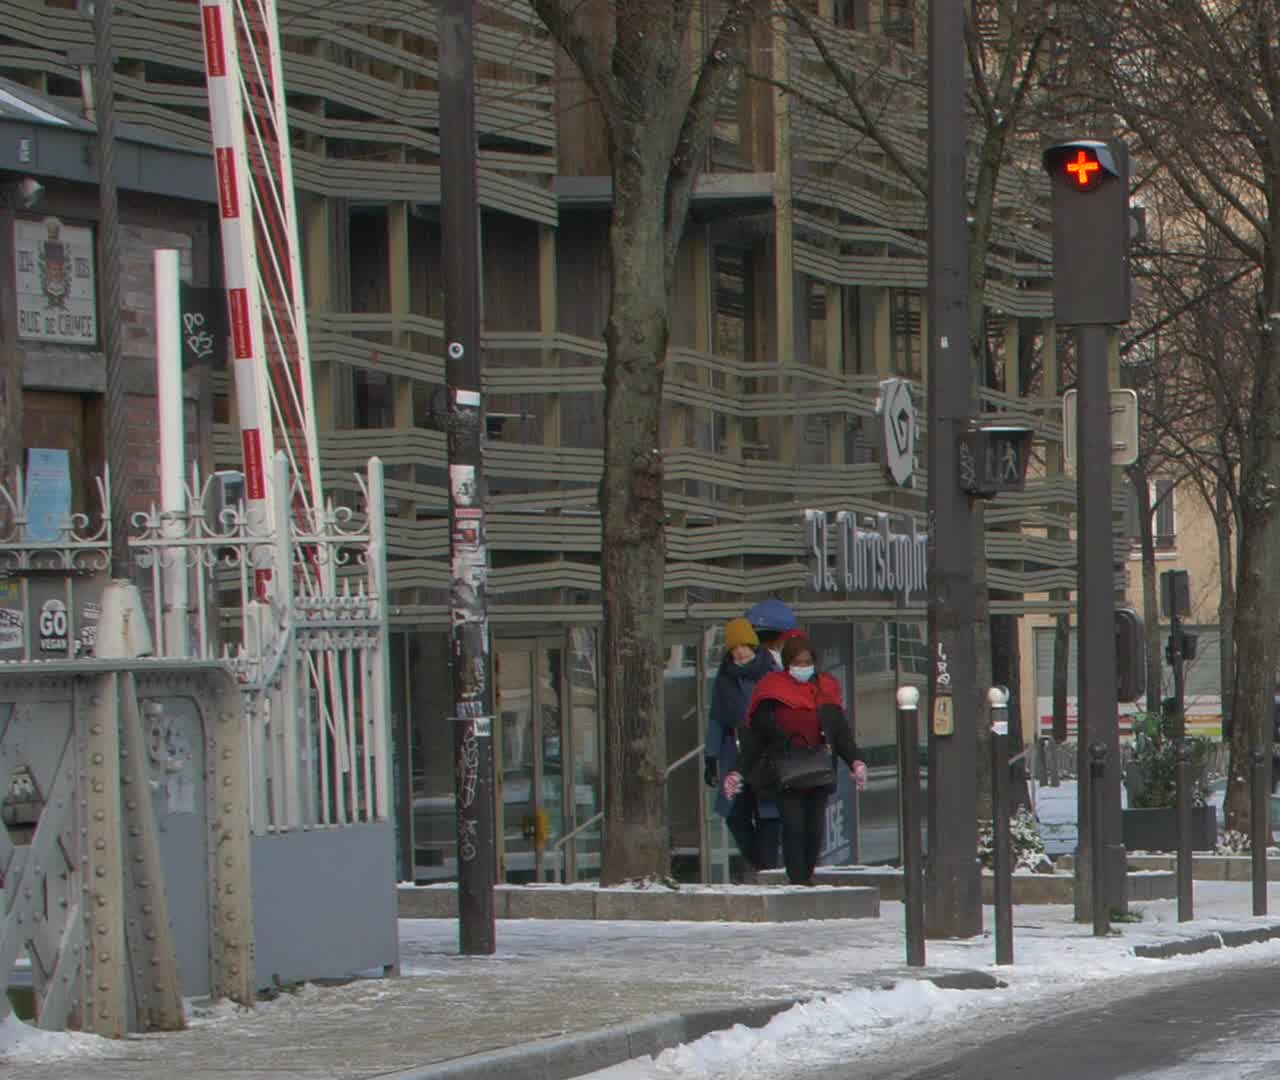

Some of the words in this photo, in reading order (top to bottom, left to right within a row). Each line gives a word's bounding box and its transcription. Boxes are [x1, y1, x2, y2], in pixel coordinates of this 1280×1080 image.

[19, 309, 41, 333] RUE
[39, 611, 67, 637] GO
[40, 638, 67, 650] VEGAN
